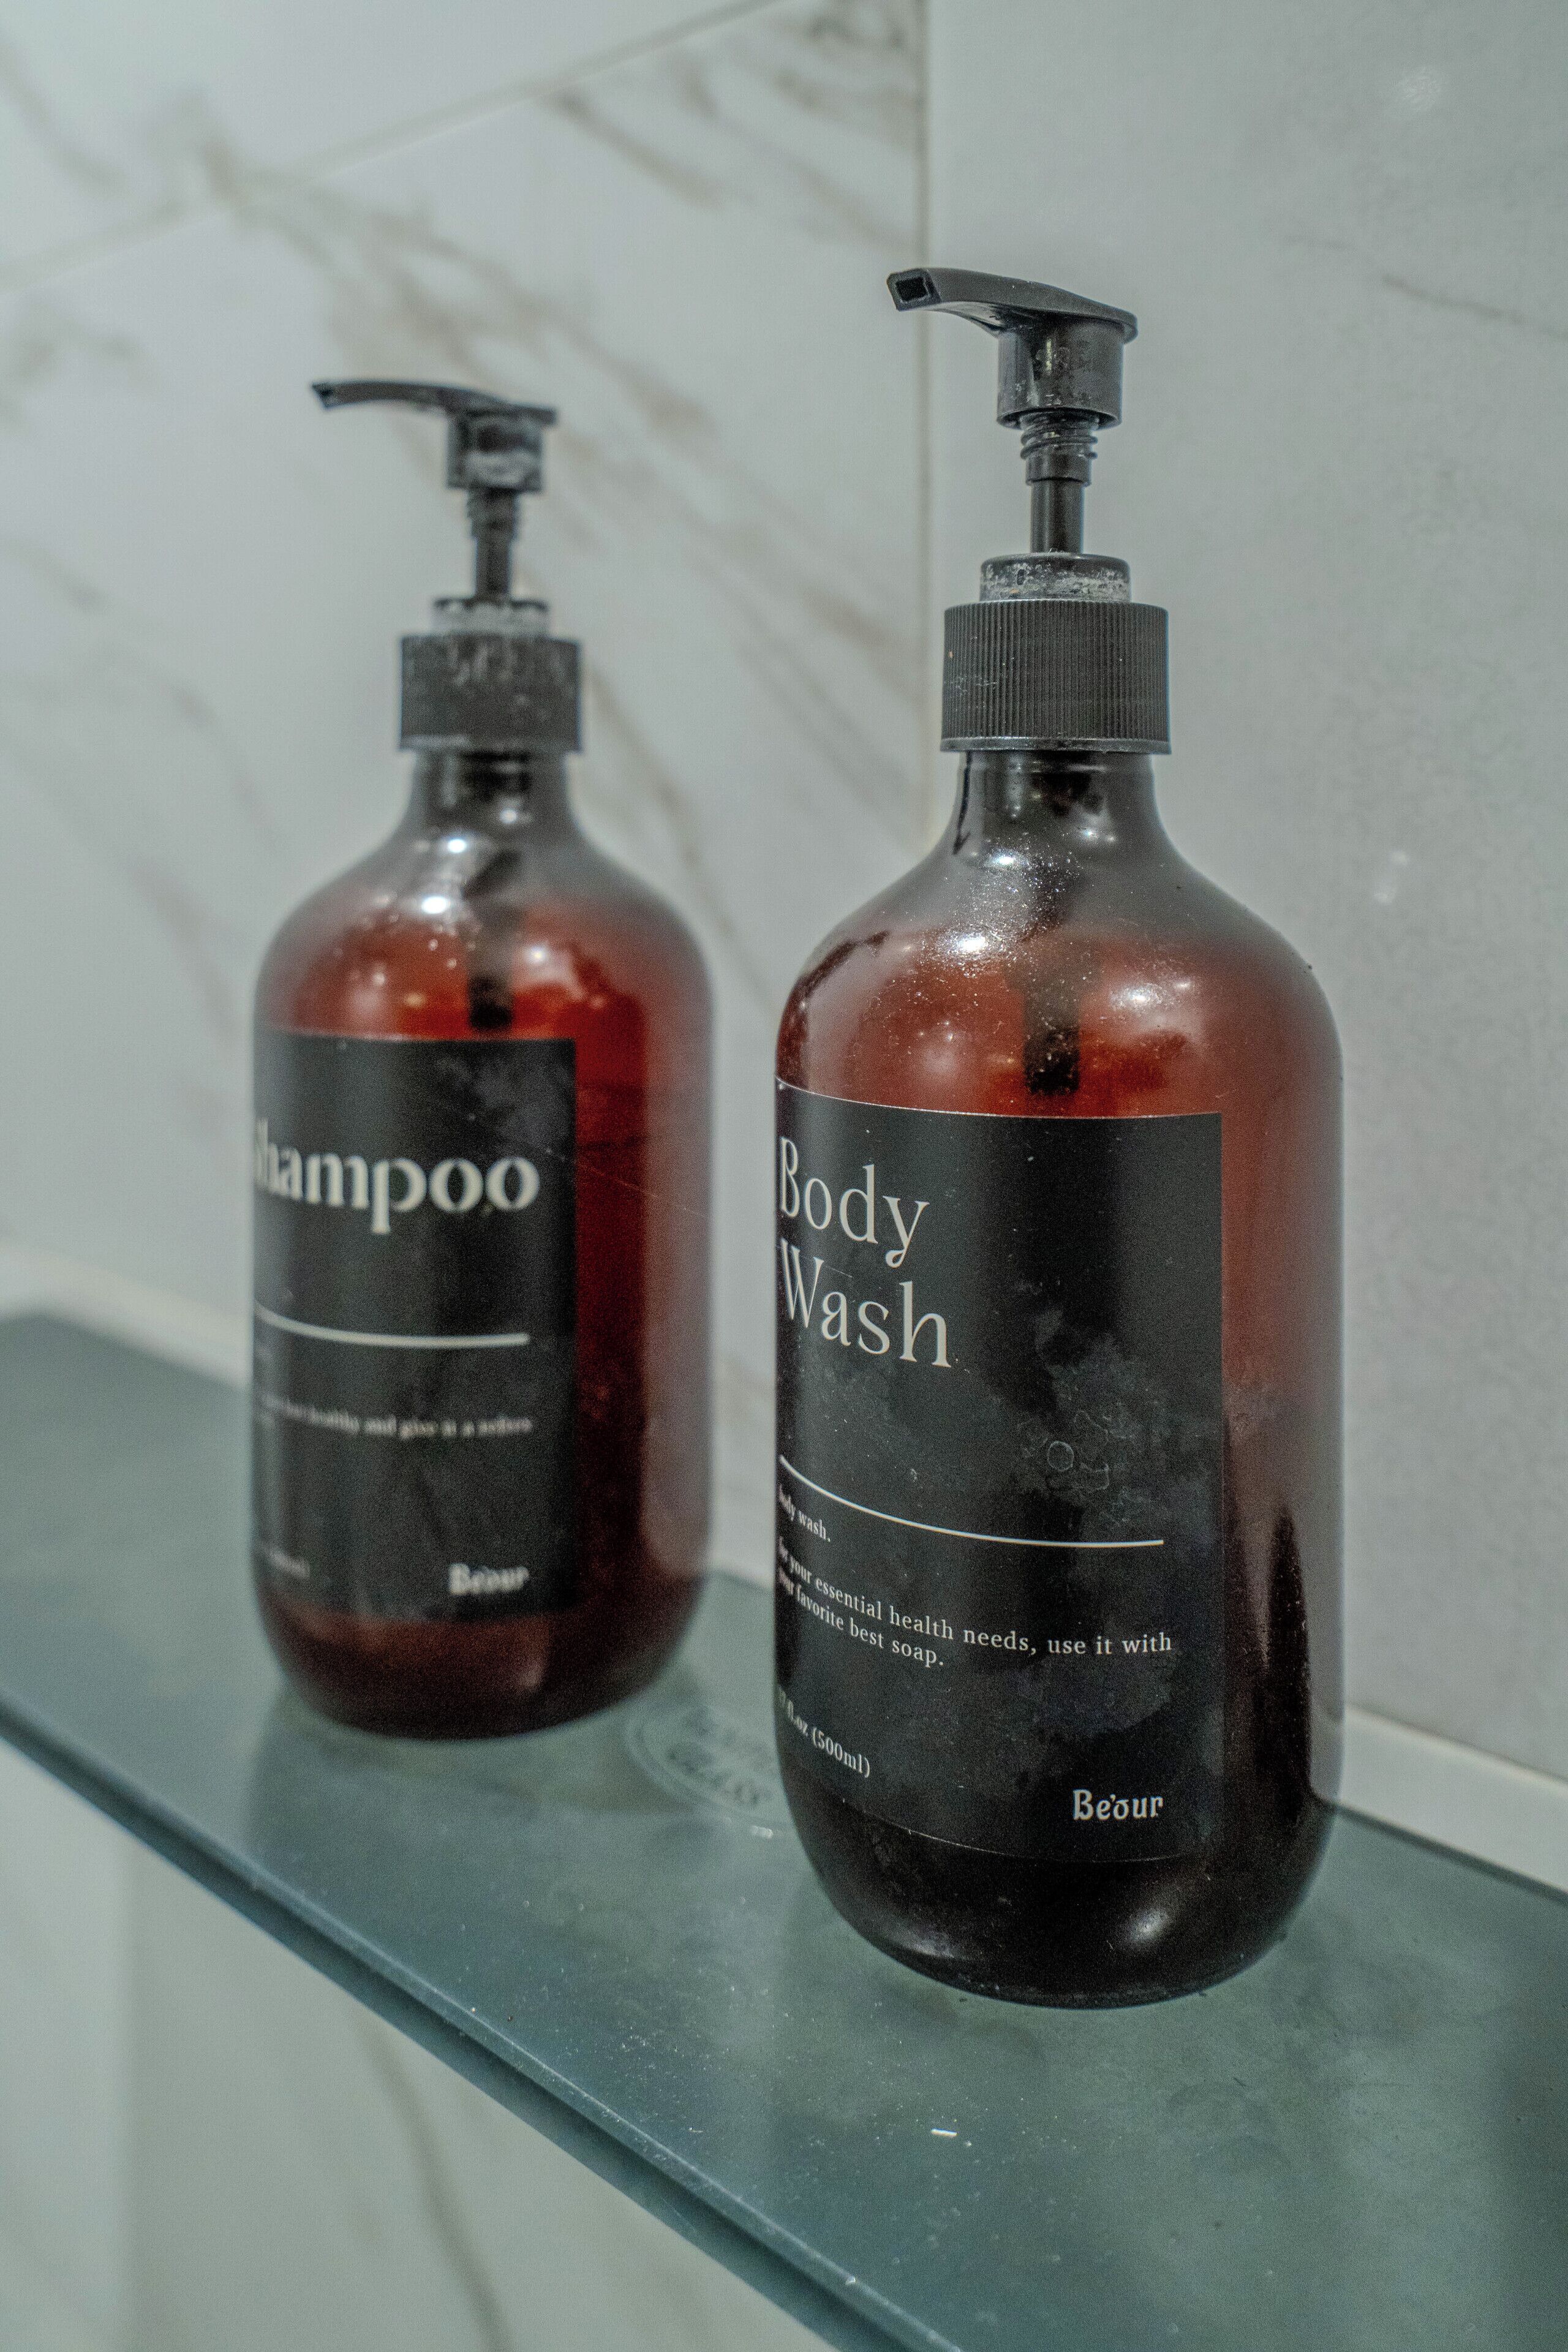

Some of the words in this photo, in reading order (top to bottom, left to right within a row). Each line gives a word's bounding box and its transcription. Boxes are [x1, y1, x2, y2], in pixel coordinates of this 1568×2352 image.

[254, 1117, 540, 1235] hampoo
[780, 1137, 930, 1268] Body
[780, 1238, 952, 1368] Wash
[798, 1509, 831, 1542] wash.
[796, 1584, 844, 1631] favorite
[850, 1617, 884, 1649] best
[891, 1638, 944, 1668] soap.
[815, 1576, 882, 1621] essential
[889, 1605, 954, 1640] health
[963, 1629, 1037, 1656] needs,
[1047, 1638, 1087, 1654] use
[1096, 1635, 1113, 1655] it
[1121, 1631, 1172, 1654] with
[812, 1727, 870, 1779] (500ml)
